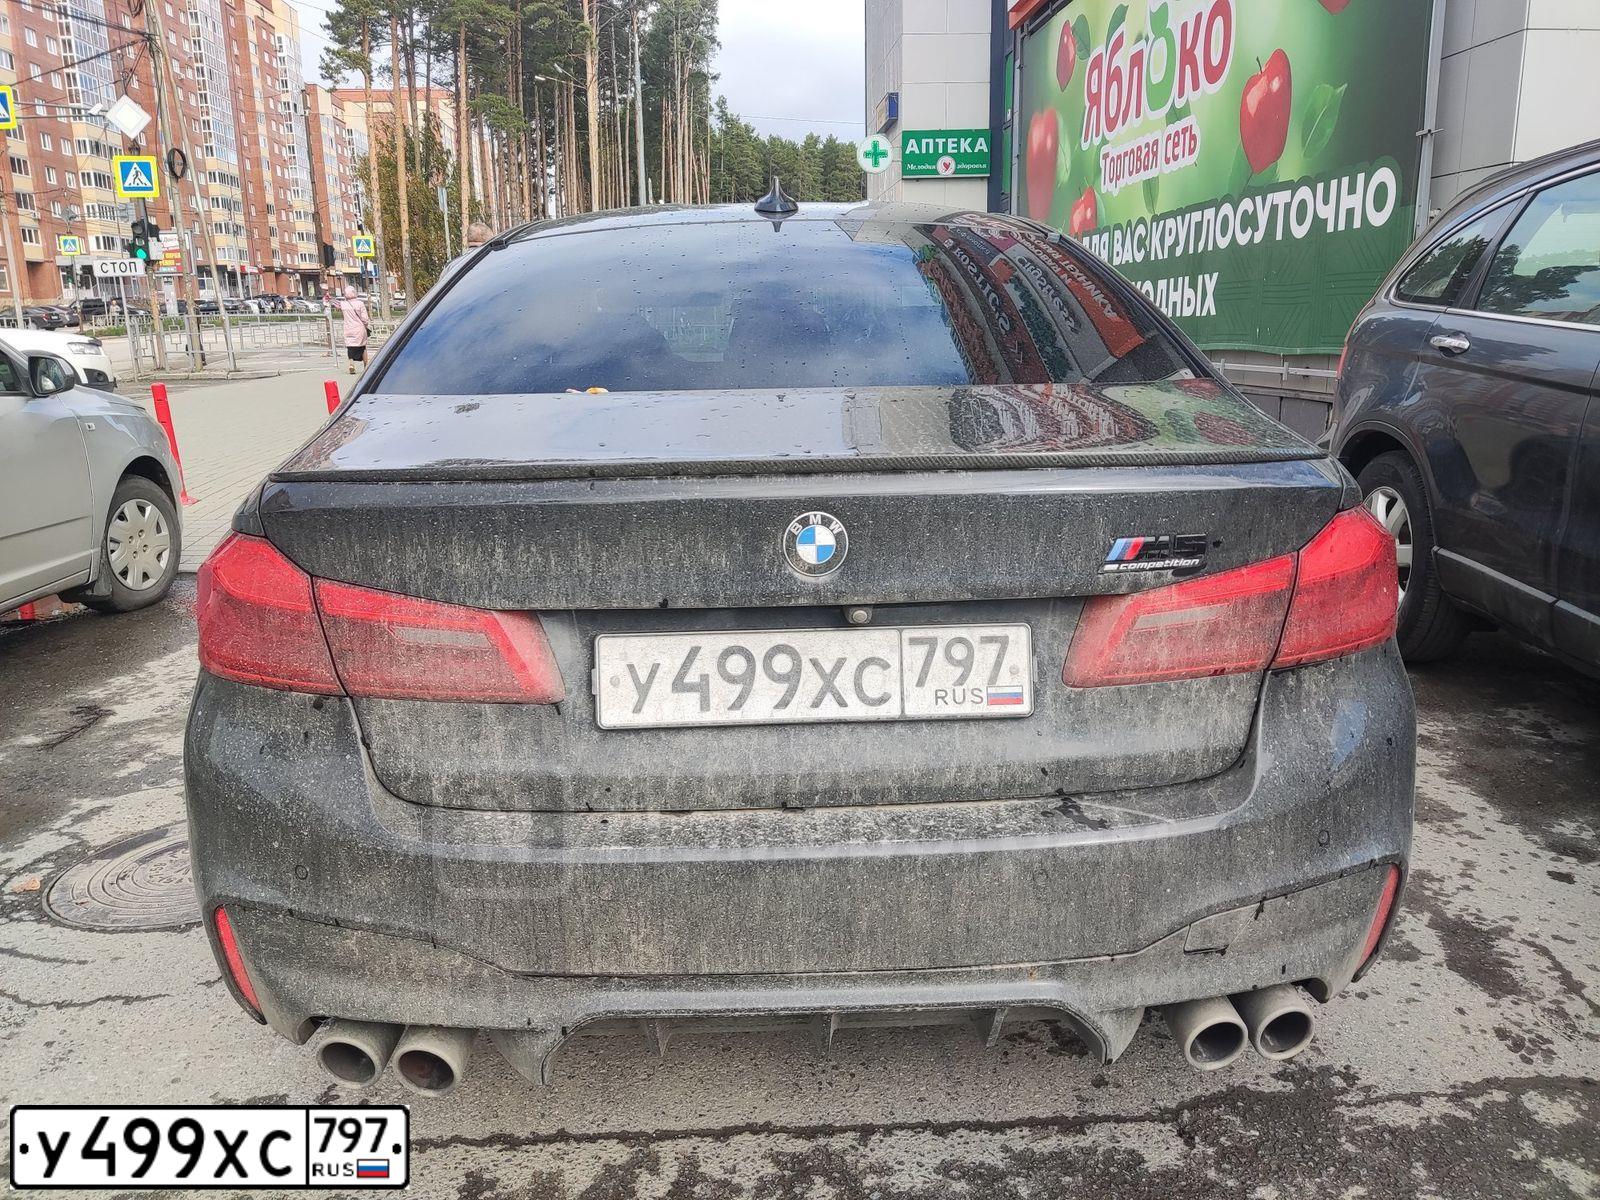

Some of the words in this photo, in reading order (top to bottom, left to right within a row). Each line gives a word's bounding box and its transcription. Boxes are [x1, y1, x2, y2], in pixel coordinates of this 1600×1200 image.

[1083, 0, 1233, 144] Яблоко
[905, 137, 989, 154] АПТЕКА
[1101, 138, 1159, 189] Торговая
[1164, 124, 1198, 165] сеть
[1112, 223, 1147, 266] ВАС
[1150, 166, 1397, 261] КРУГЛОСУТОЧНО
[100, 261, 137, 274] СТОП
[790, 514, 843, 535] BMW
[1119, 558, 1200, 571] competition
[907, 635, 1011, 688] 797
[934, 686, 985, 706] RUS
